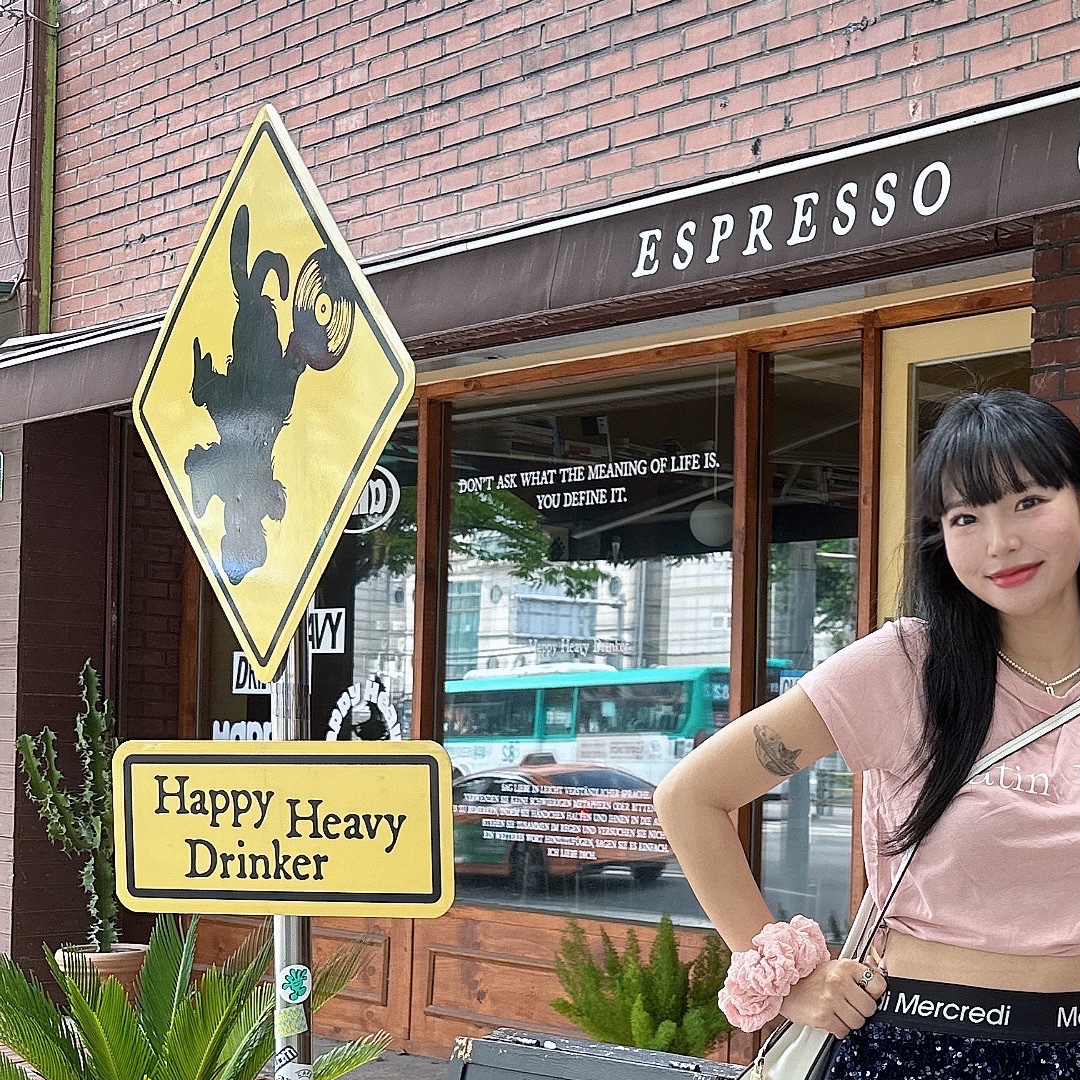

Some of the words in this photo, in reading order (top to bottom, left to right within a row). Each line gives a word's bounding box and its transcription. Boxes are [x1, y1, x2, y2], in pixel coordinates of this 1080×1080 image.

[631, 160, 953, 279] ESPRESSO
[458, 477, 494, 494] DON'T
[496, 474, 517, 490] ASK
[520, 470, 557, 488] WHAT
[559, 466, 585, 483] THE
[587, 459, 647, 481] MEANING
[650, 457, 669, 473] OF
[671, 453, 701, 473] LIFE
[703, 451, 720, 469] IS.
[536, 492, 562, 510] YOU
[563, 487, 609, 508] DEFINE
[610, 487, 628, 503] IT.
[308, 612, 343, 650] AVY
[529, 639, 559, 658] Happy
[561, 638, 591, 658] Heavy
[968, 762, 1050, 797] atin
[154, 775, 275, 829] Happy
[287, 798, 406, 855] Heavy
[184, 839, 329, 882] Drinker
[895, 992, 1011, 1026] Mercredi
